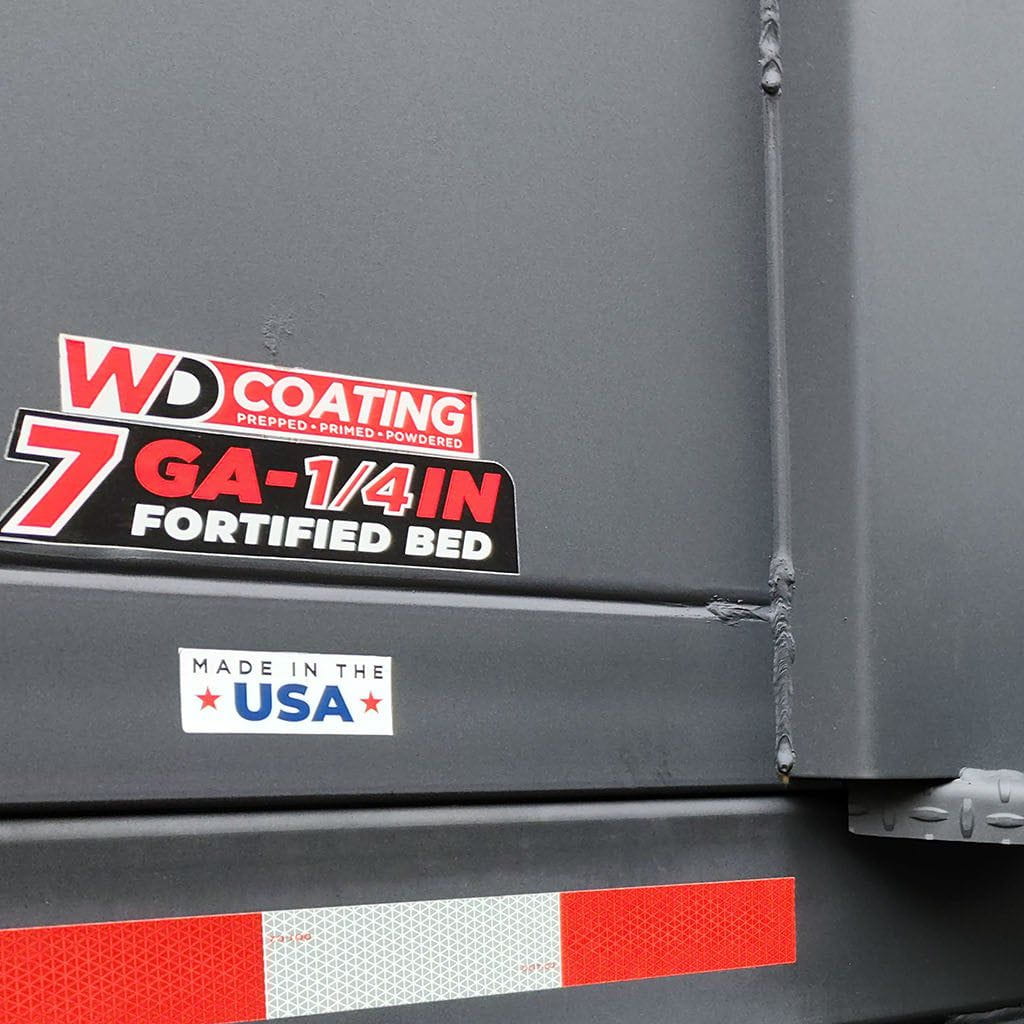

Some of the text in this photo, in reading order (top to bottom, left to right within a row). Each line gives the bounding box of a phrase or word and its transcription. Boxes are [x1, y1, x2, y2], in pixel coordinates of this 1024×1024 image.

[65, 339, 465, 435] WD COATING
[237, 412, 463, 449] PREPPED PRIMED POWDERED
[3, 416, 129, 536] 7
[131, 504, 493, 561] FORTIFIED BED
[193, 657, 384, 679] MADE IN THE
[234, 682, 354, 722] USA
